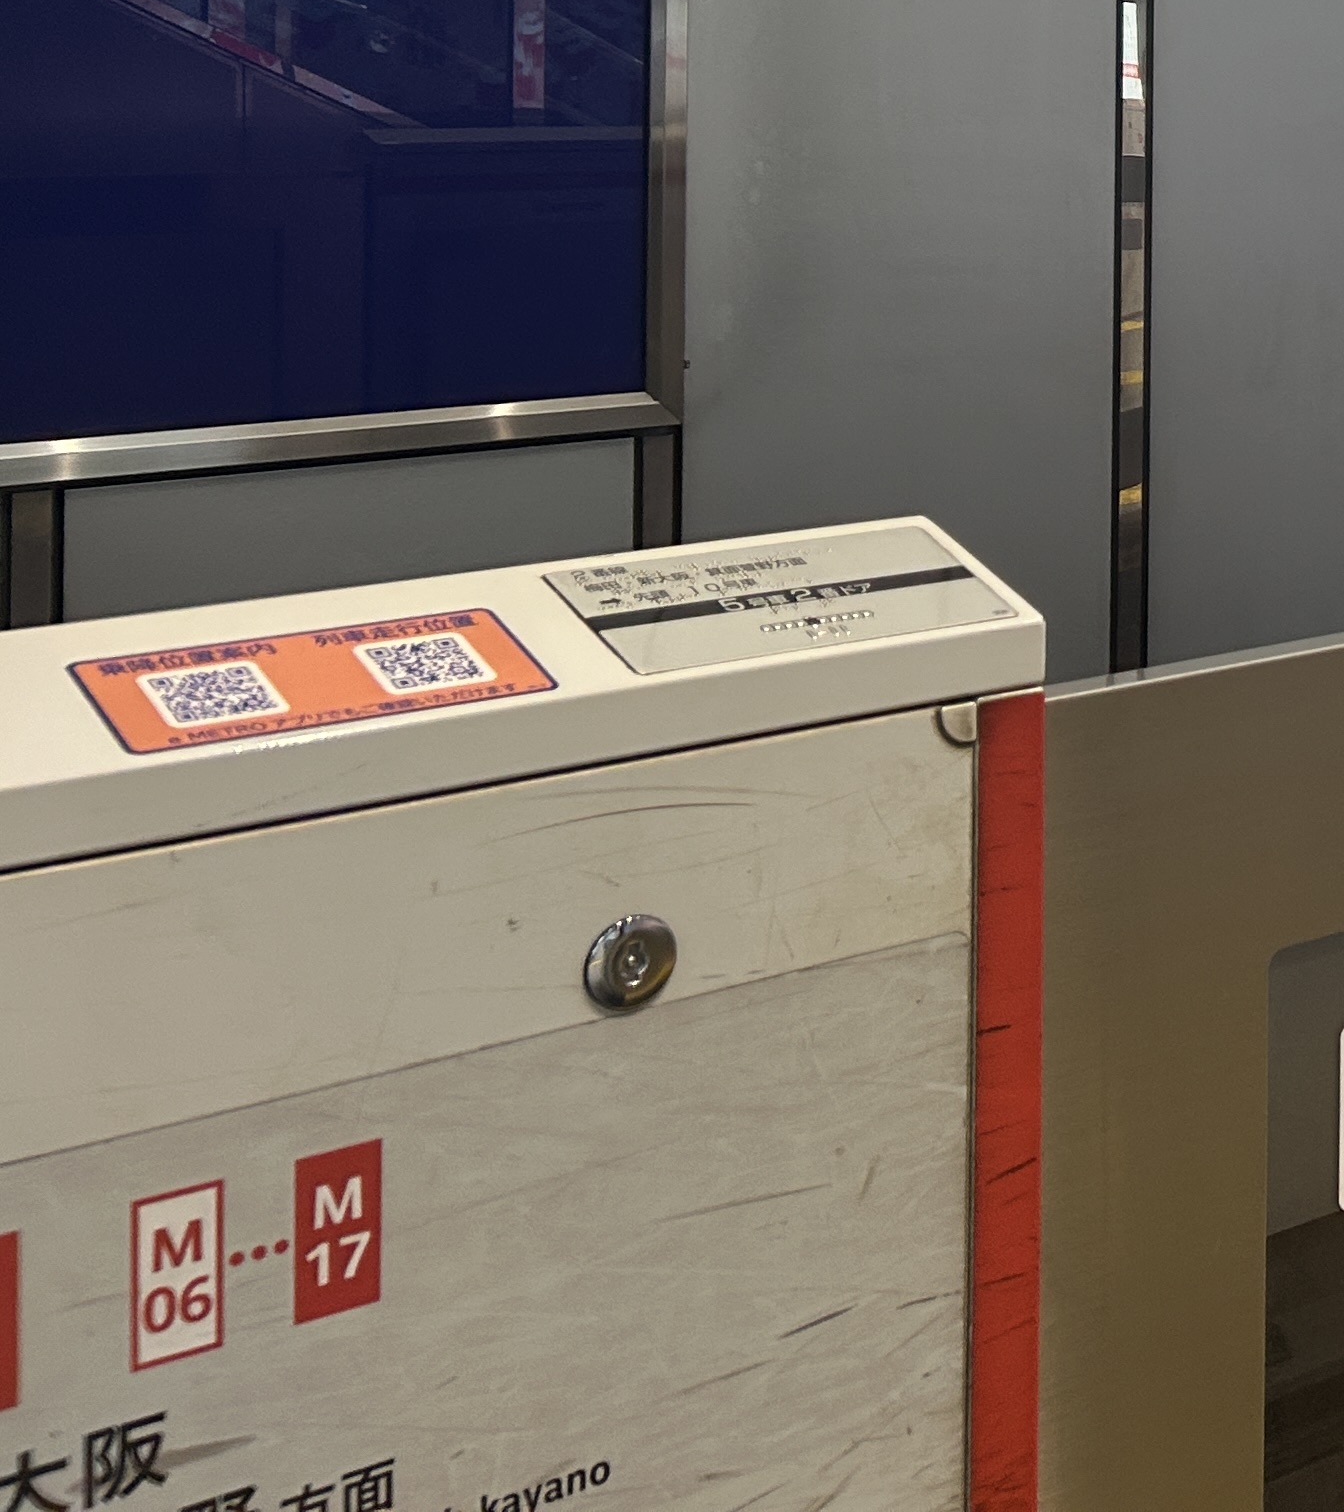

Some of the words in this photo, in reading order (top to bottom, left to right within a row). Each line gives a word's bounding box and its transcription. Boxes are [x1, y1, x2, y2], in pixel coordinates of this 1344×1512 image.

[313, 613, 479, 648] 列車走行位置
[312, 1175, 365, 1232] M
[151, 1219, 205, 1276] M
[303, 1231, 373, 1288] 17
[143, 1275, 213, 1334] 06
